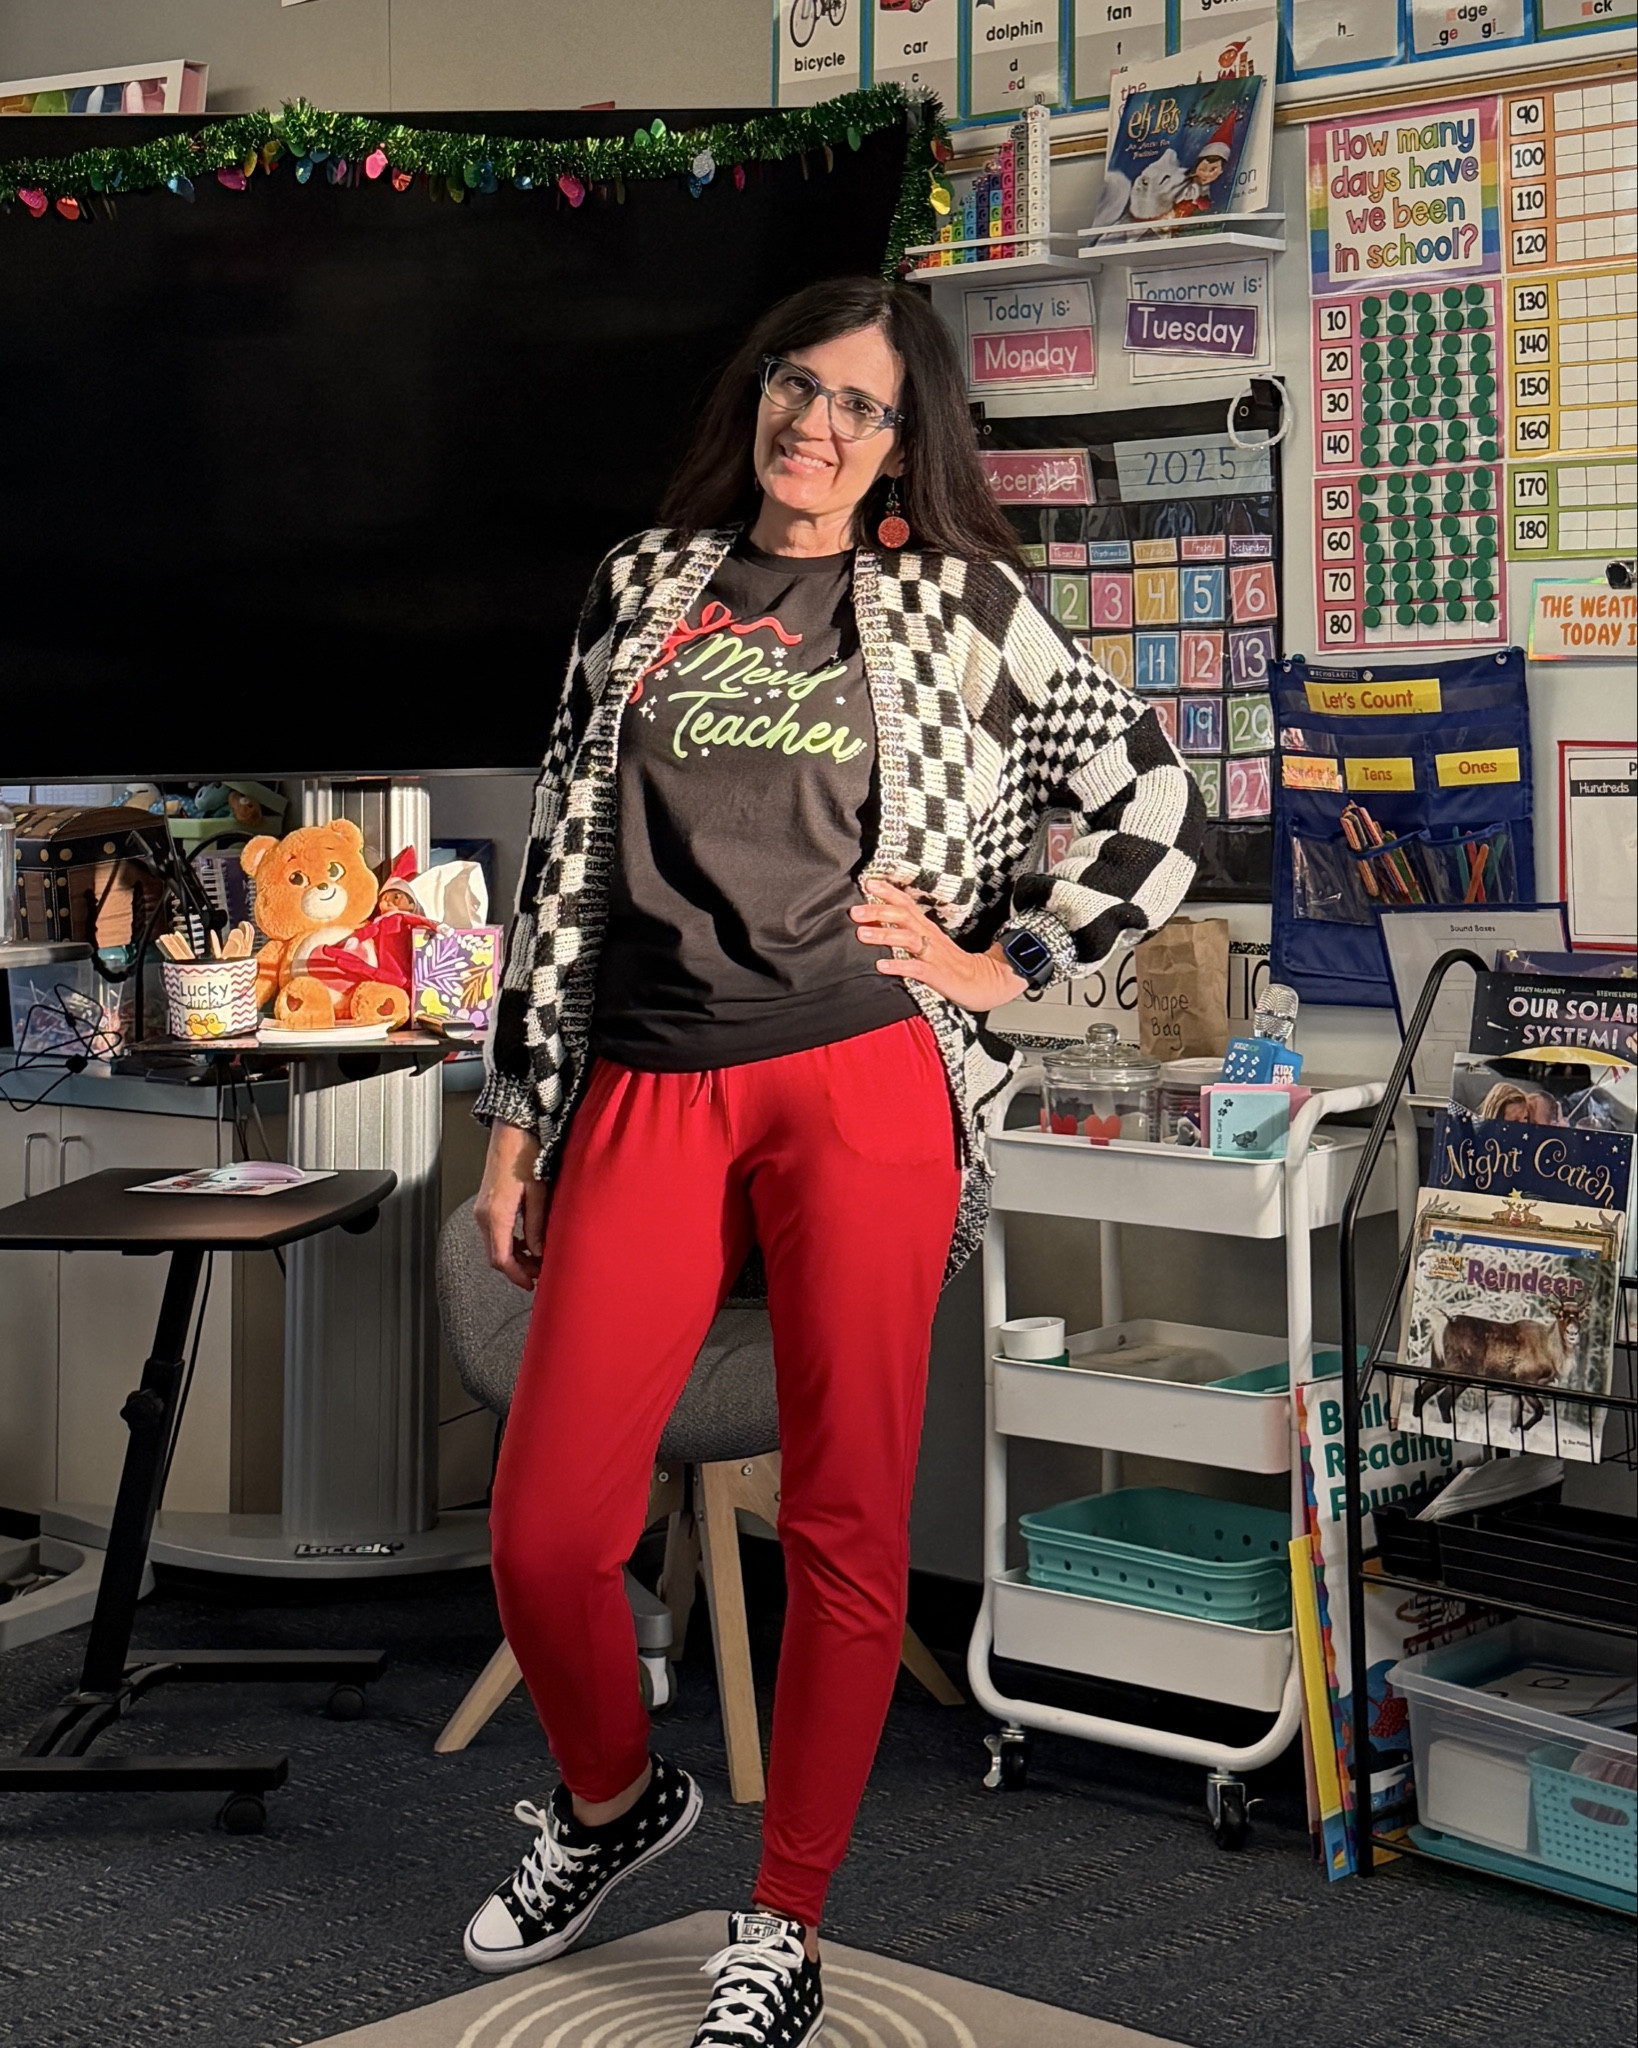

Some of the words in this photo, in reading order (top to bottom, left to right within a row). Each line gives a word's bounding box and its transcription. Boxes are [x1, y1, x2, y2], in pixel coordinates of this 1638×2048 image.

[1107, 6, 1132, 21] fan
[1457, 3, 1487, 21] dge
[986, 20, 1043, 41] dolphin
[903, 40, 928, 55] car
[1117, 42, 1123, 55] f
[794, 52, 846, 72] bicycle
[1009, 59, 1018, 72] d
[911, 72, 919, 83] c
[1516, 105, 1539, 124] 90
[1332, 129, 1388, 162] How
[1396, 118, 1475, 153] many
[1514, 147, 1544, 168] 100
[1331, 166, 1401, 202] days
[1409, 156, 1479, 189] have
[1516, 191, 1543, 211] 110
[1346, 207, 1387, 235] we
[1393, 196, 1465, 229] been
[1335, 242, 1359, 273] in
[1367, 224, 1479, 268] school?
[1516, 234, 1546, 254] 120
[1134, 278, 1235, 300] Tomorrow
[1243, 275, 1263, 293] is:
[984, 297, 1044, 324] Today
[1051, 299, 1070, 317] is:
[1518, 292, 1546, 311] 130
[1137, 307, 1245, 353] Tuesday
[1327, 311, 1346, 331] 10
[985, 336, 1078, 371] Monday
[1519, 334, 1547, 354] 140
[1326, 352, 1348, 372] 20
[1519, 377, 1549, 396] 150
[1327, 393, 1349, 413] 30
[1519, 421, 1549, 440] 160
[1327, 434, 1350, 454] 40
[990, 462, 1077, 492] ecember
[1144, 447, 1236, 486] 2025
[1518, 478, 1546, 497] 170
[1327, 491, 1349, 510] 50
[1518, 521, 1547, 539] 180
[1191, 539, 1216, 553] Friday
[1232, 541, 1268, 555] Saturday
[1327, 532, 1350, 551] 60
[1245, 572, 1265, 612] 6
[1328, 573, 1350, 592] 70
[1062, 583, 1078, 621] 2
[1104, 583, 1122, 621] 3
[1148, 577, 1166, 615] 4
[1193, 575, 1213, 614] 5
[1541, 595, 1574, 619] THE
[1330, 614, 1351, 634] 80
[1561, 622, 1621, 646] TODAY
[678, 633, 847, 701] Merry
[1149, 644, 1165, 681] 11
[1189, 640, 1214, 678] 12
[1239, 638, 1267, 678] 13
[1322, 691, 1355, 709] Let's
[1361, 690, 1414, 709] Count
[668, 691, 863, 758] Teacher
[1187, 706, 1213, 744] 19
[1234, 704, 1274, 742] 20
[1362, 767, 1392, 781] Tens
[1459, 761, 1497, 774] Ones
[1231, 769, 1266, 809] 27
[1579, 782, 1630, 794] Hundreds
[180, 981, 228, 998] Lucky
[1143, 980, 1189, 1019] Shape
[1509, 997, 1559, 1019] OUR
[1564, 1000, 1637, 1024] SOLAR
[1152, 1017, 1181, 1050] Bag
[1522, 1025, 1618, 1050] SYSTEM!
[1273, 1064, 1294, 1076] KIDZ
[1440, 1138, 1523, 1190] Night
[1534, 1138, 1615, 1209] Catch
[1467, 1258, 1584, 1298] Reindeer
[1319, 1393, 1390, 1436] Bil
